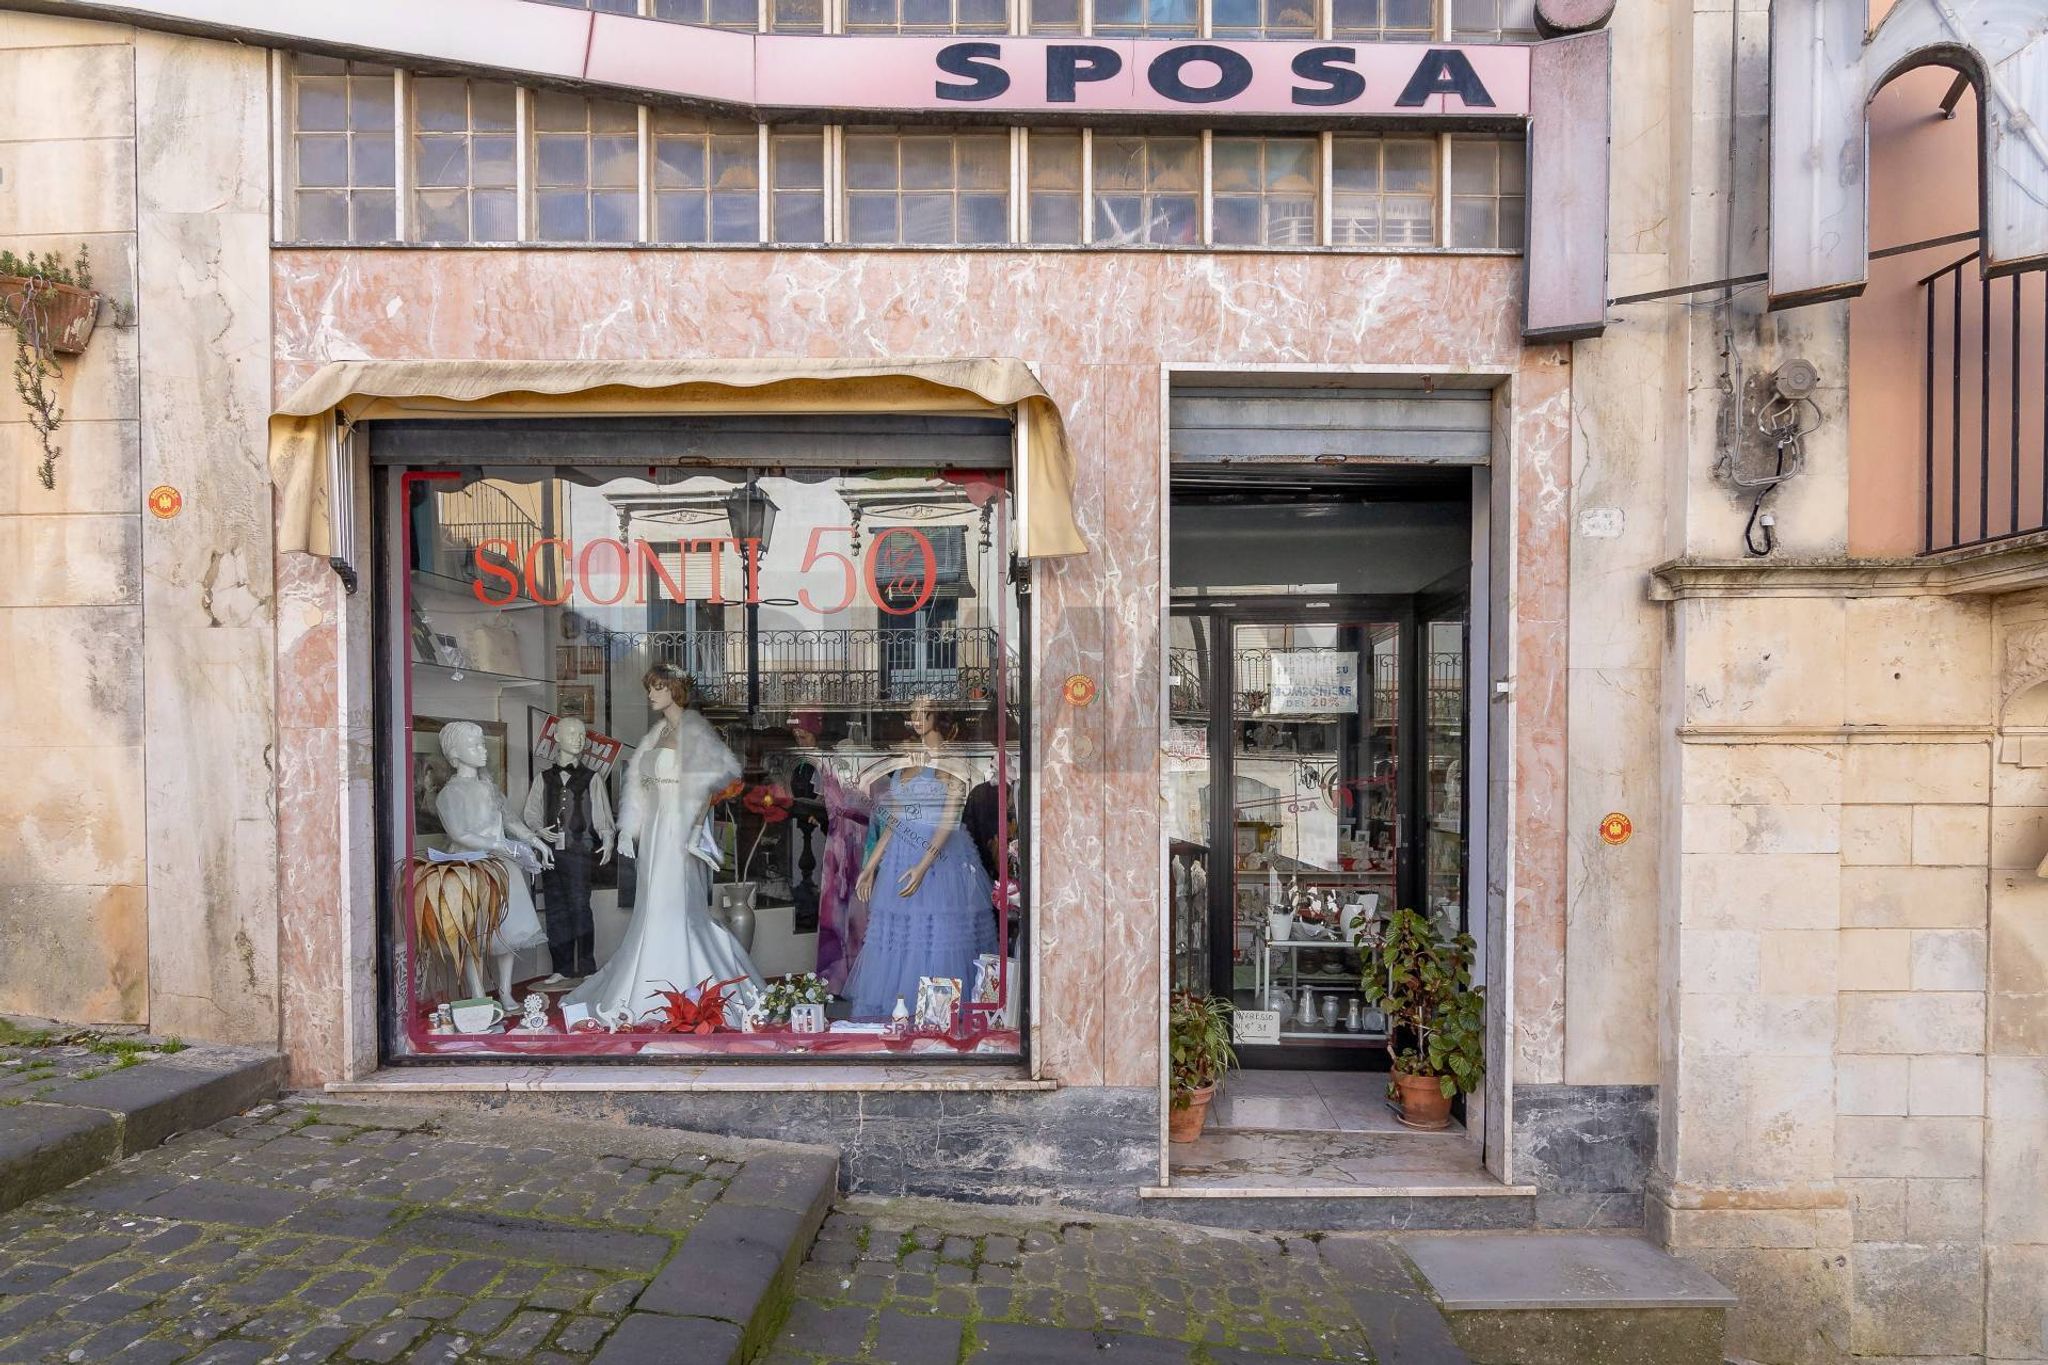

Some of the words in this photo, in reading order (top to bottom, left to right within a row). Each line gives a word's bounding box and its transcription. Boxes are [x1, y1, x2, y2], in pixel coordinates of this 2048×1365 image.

[936, 42, 1497, 107] SPOSA
[473, 537, 764, 606] SCONTI
[883, 1023, 942, 1035] SPOSA
